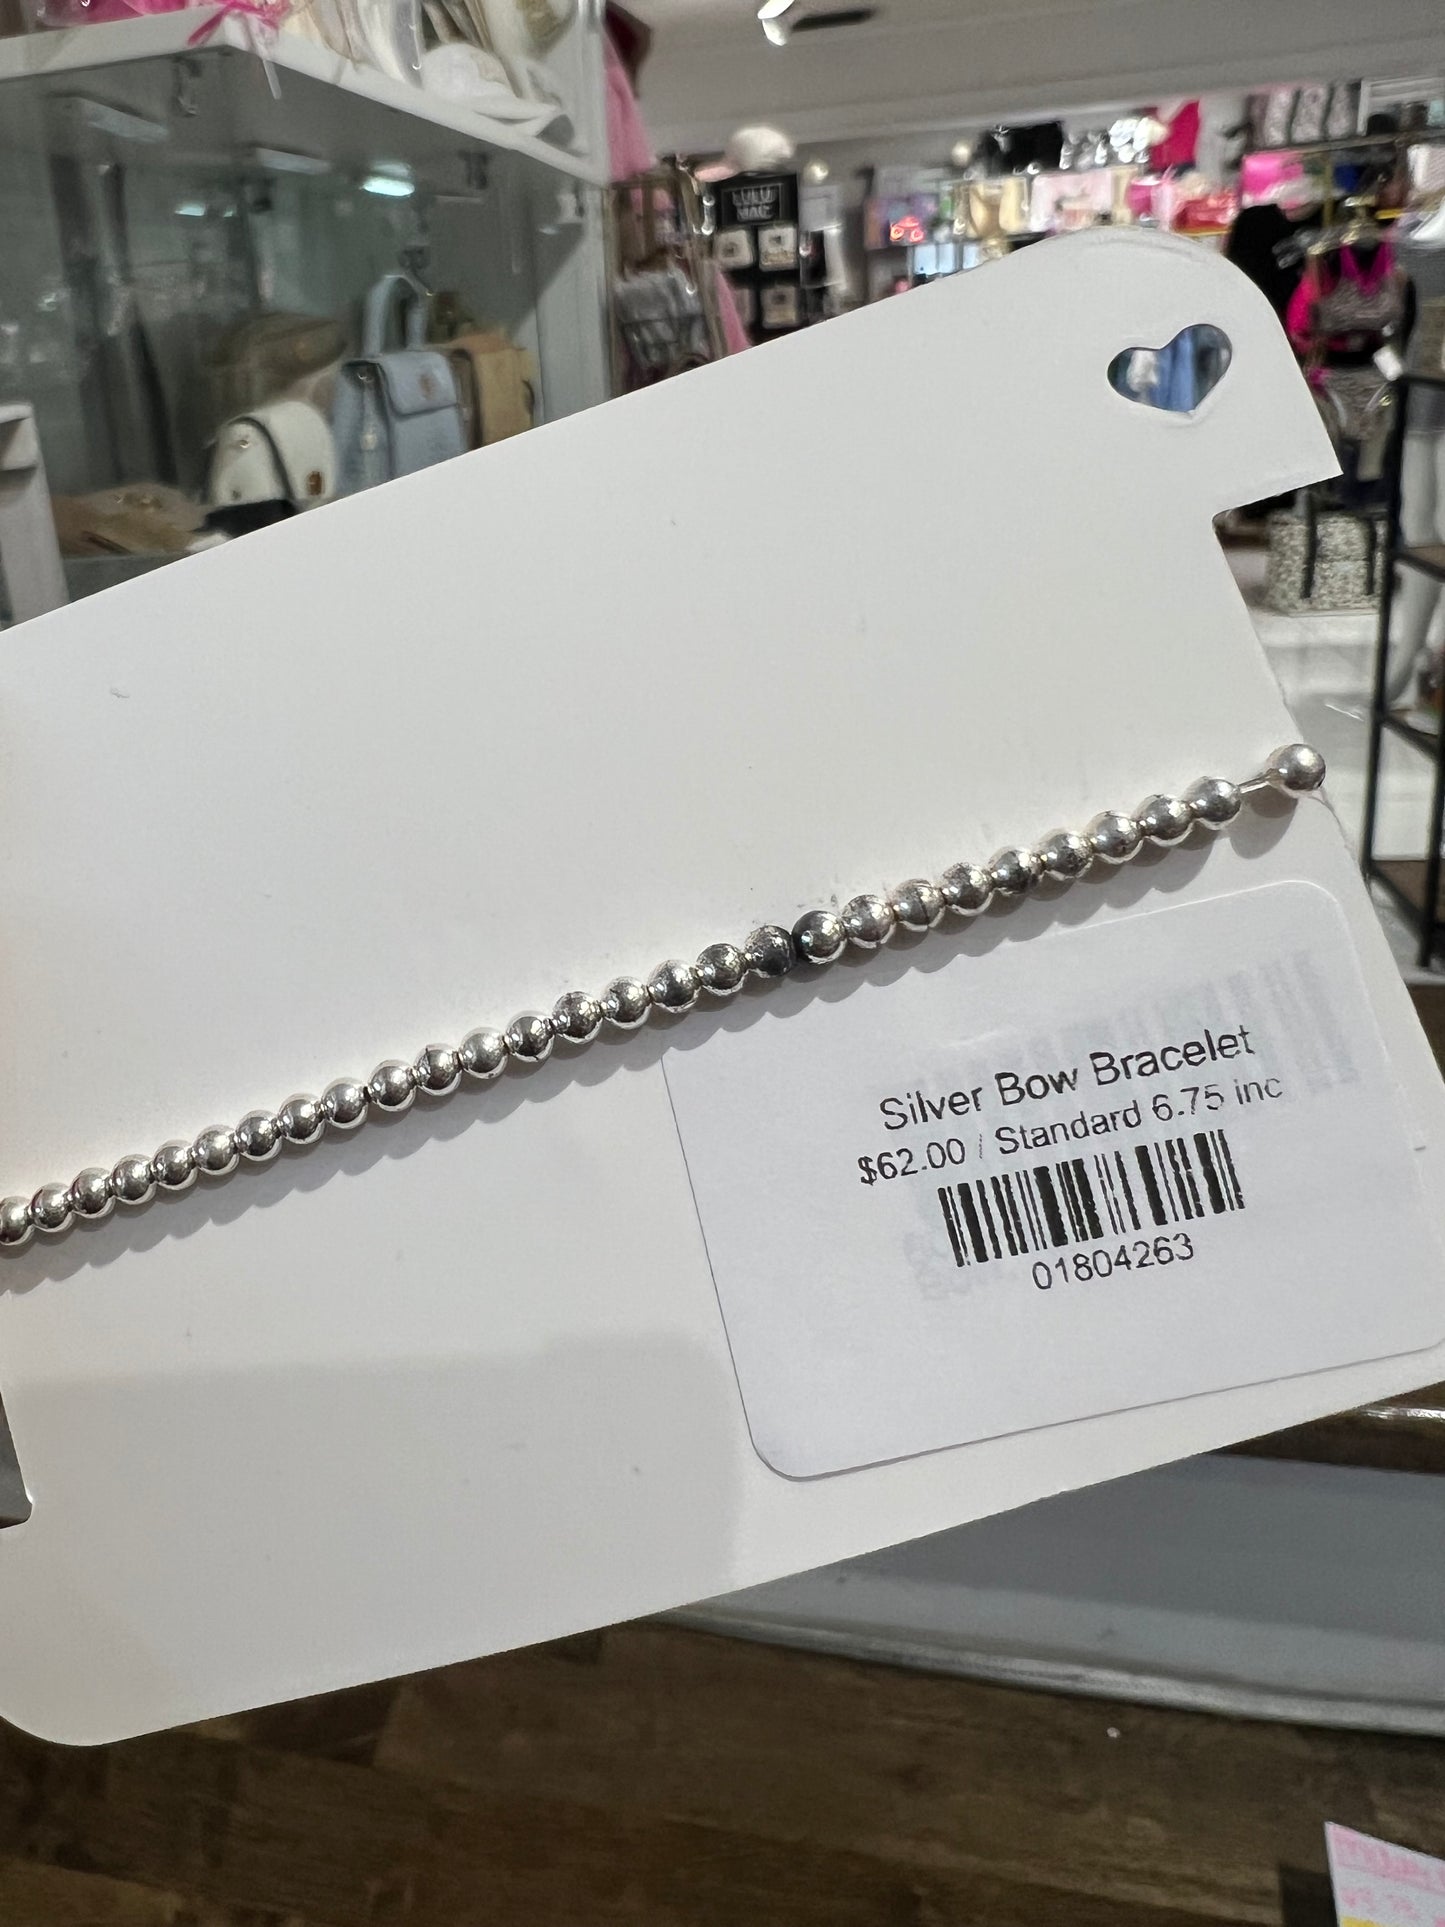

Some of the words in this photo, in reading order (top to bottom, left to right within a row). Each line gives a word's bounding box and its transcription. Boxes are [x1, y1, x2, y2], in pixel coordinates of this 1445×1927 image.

[879, 1086, 983, 1131] Silver
[994, 1068, 1078, 1106] Bow
[1089, 1024, 1256, 1086] Bracelet
[857, 1138, 966, 1186] $62.00
[994, 1099, 1142, 1155] Standard
[1151, 1083, 1225, 1122] 6.75
[1233, 1078, 1284, 1105] inc
[1031, 1232, 1195, 1291] 01804263
